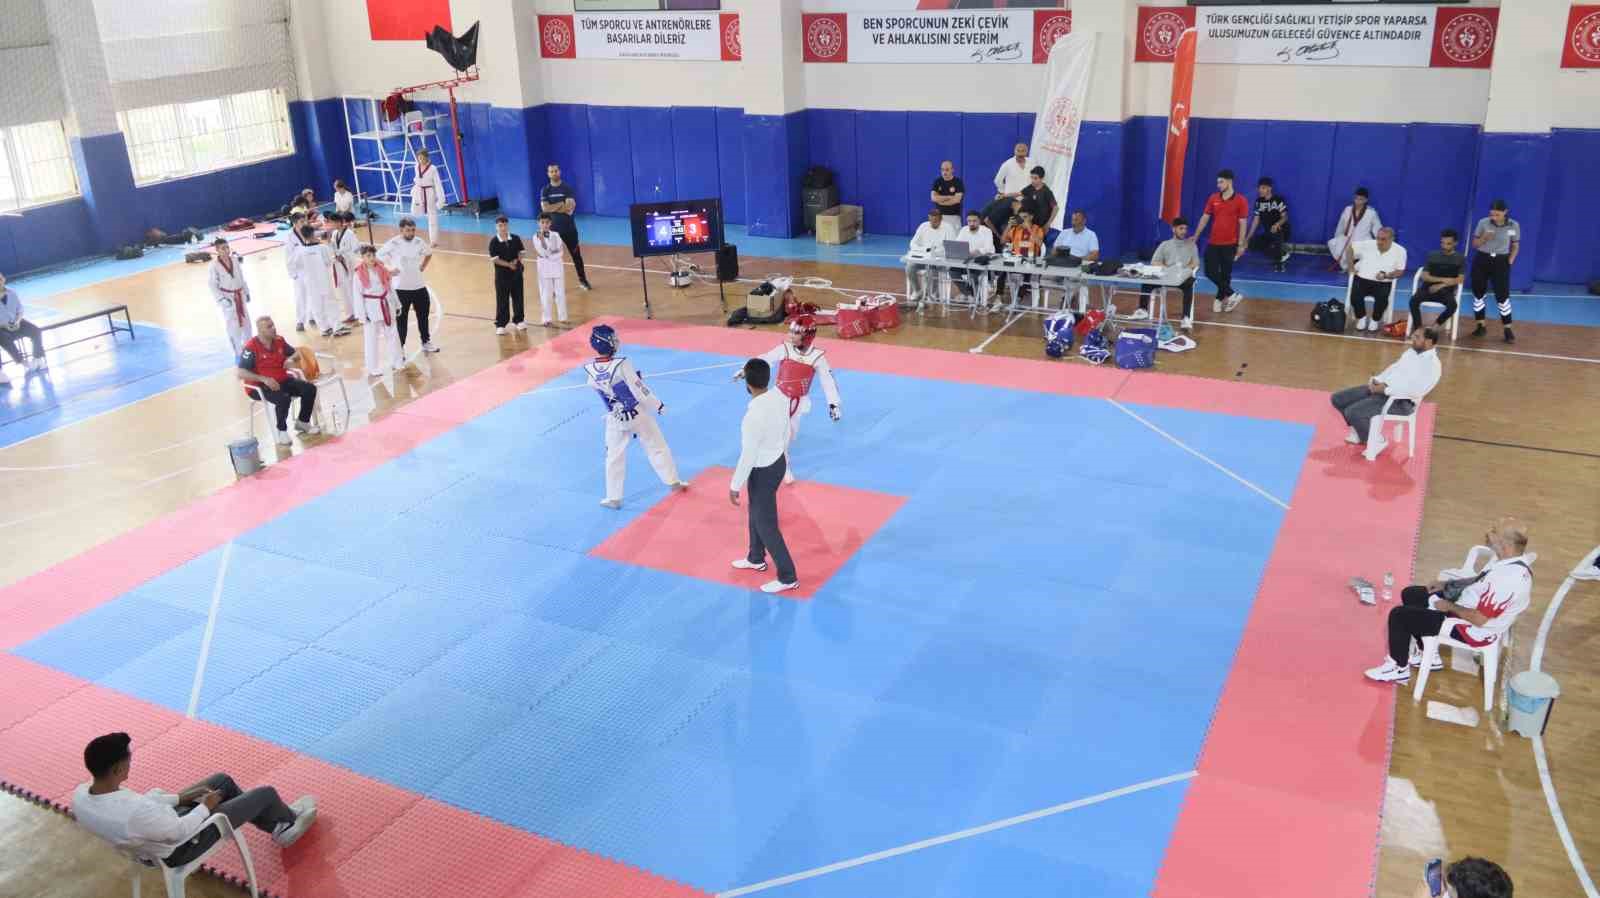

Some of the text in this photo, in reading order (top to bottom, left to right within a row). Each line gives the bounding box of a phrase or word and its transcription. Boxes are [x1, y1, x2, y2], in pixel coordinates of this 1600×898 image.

[581, 17, 712, 30] TÜM SPORCU VE ANTRENÖRLERE
[863, 14, 1009, 30] BEN SPORCUNUN ZEKİ ÇEVİK
[1206, 12, 1428, 26] TÜRK GENÇLİĞİ SAĞLIKLI YETİŞİP SPOR YAPARSA
[607, 31, 687, 46] BAŞARILAR DİLERİZ
[872, 30, 999, 45] VE AHLAKLISINI SEVERİM
[1208, 27, 1422, 40] ULUSUMUZUN GELECEĞİ GÜVENCE ALTINDADIR
